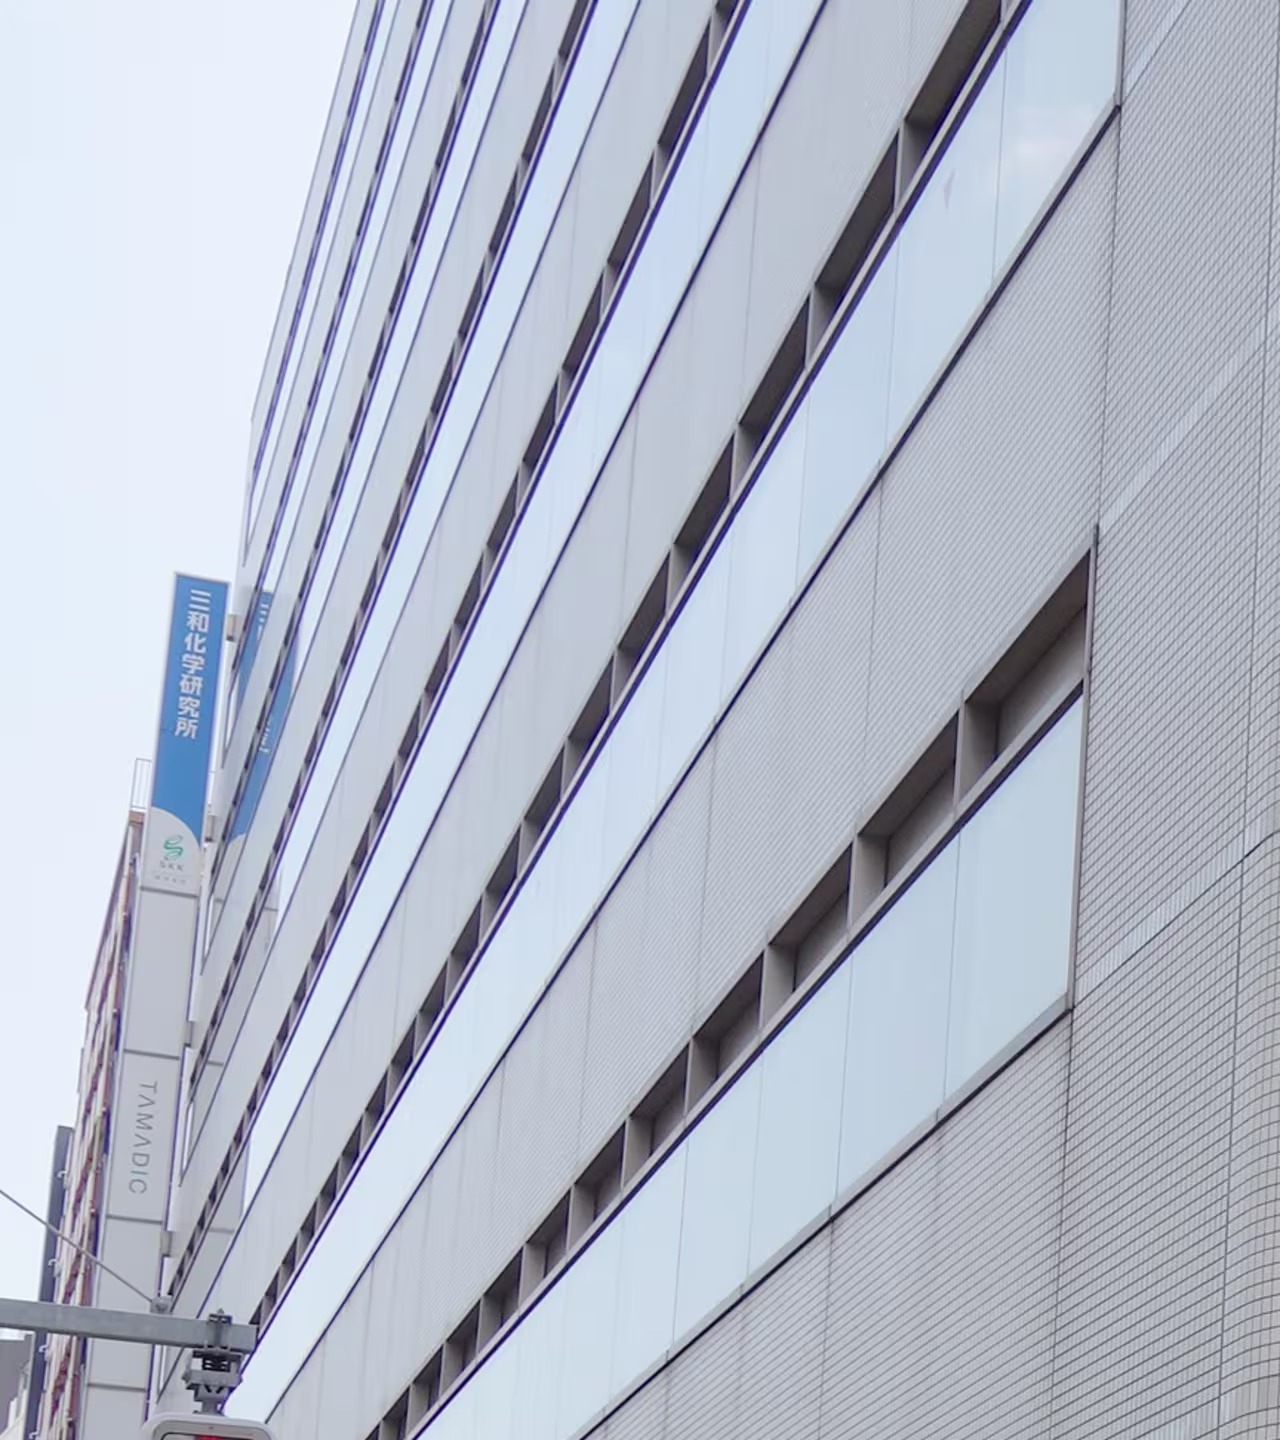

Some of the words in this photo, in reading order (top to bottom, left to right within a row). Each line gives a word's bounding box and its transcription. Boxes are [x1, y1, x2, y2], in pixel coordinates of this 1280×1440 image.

[174, 588, 211, 739] 三和化学研究所
[128, 1081, 158, 1194] TAMADIC
